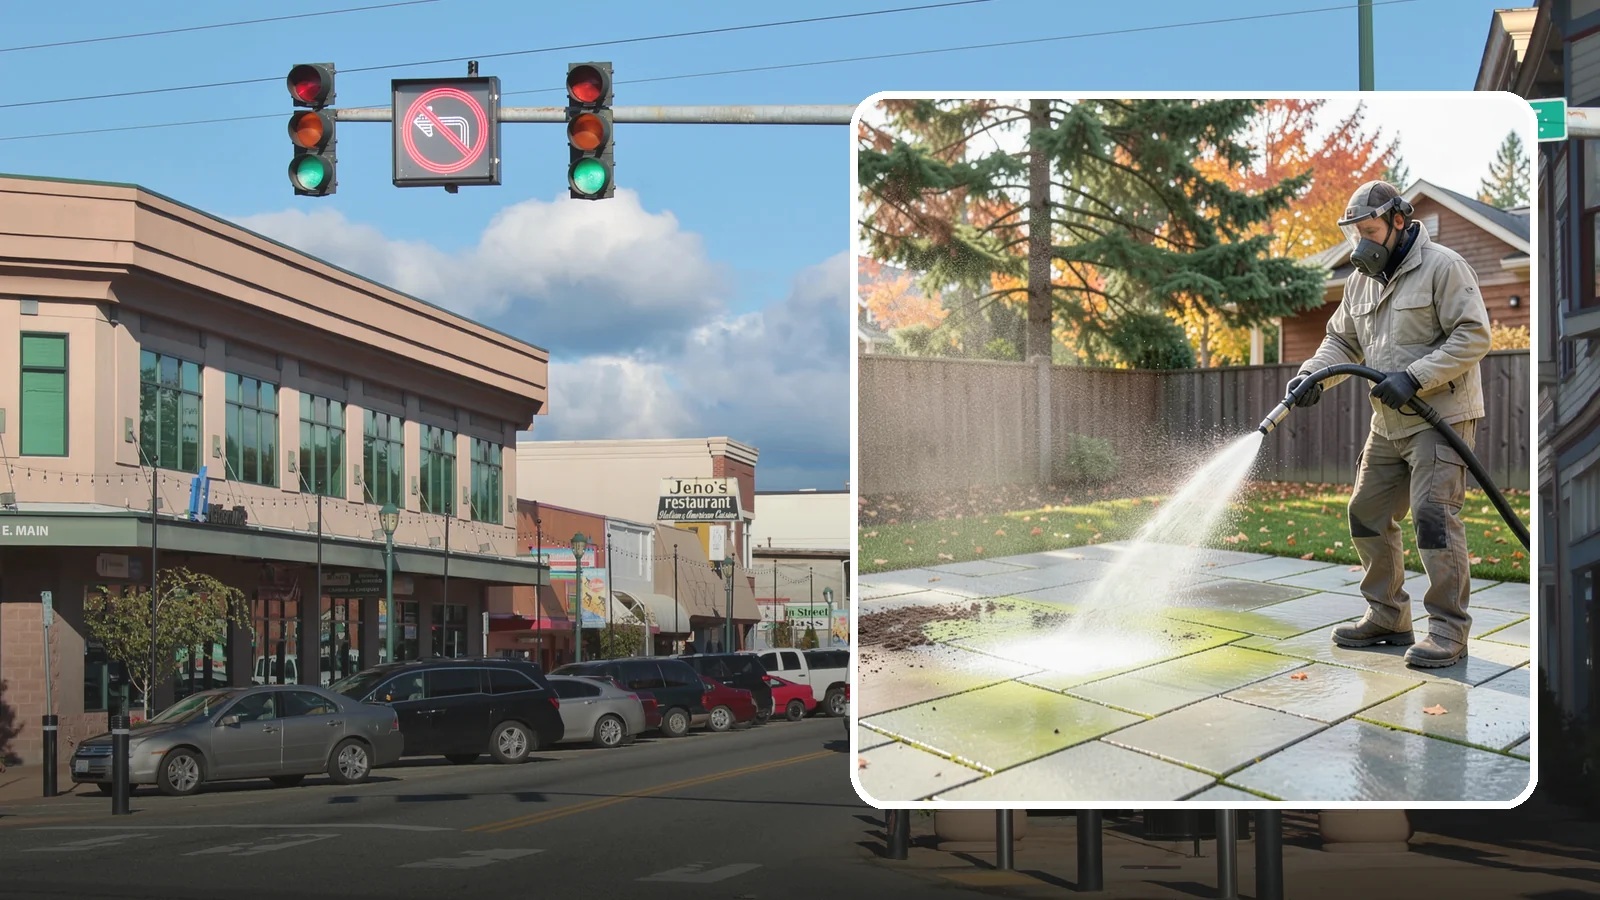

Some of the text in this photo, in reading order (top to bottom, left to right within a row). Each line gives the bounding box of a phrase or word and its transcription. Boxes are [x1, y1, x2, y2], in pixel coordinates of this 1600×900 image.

[670, 480, 727, 494] Jeno's
[665, 497, 731, 508] restaurant
[658, 510, 681, 519] Italian
[686, 509, 714, 519] American
[715, 509, 737, 519] Cuisine
[2, 525, 49, 536] E. MAIN
[797, 607, 829, 617] Street
